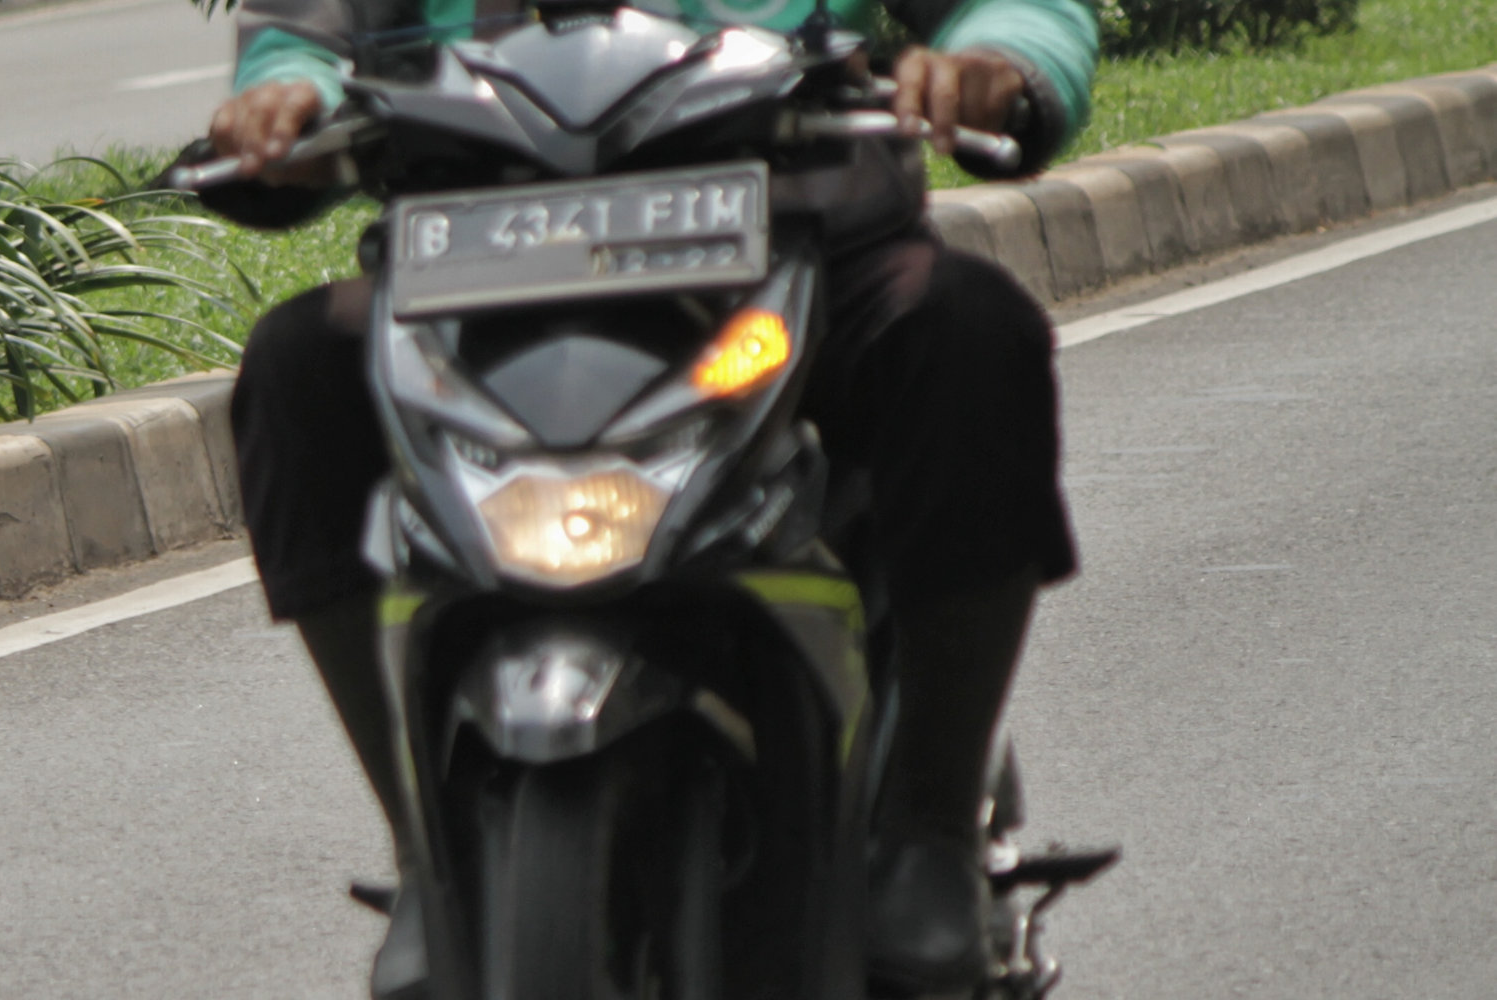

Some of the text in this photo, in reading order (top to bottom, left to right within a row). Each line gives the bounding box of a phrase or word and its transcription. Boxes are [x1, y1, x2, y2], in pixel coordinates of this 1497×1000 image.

[419, 185, 747, 258] B 4341 FIM
